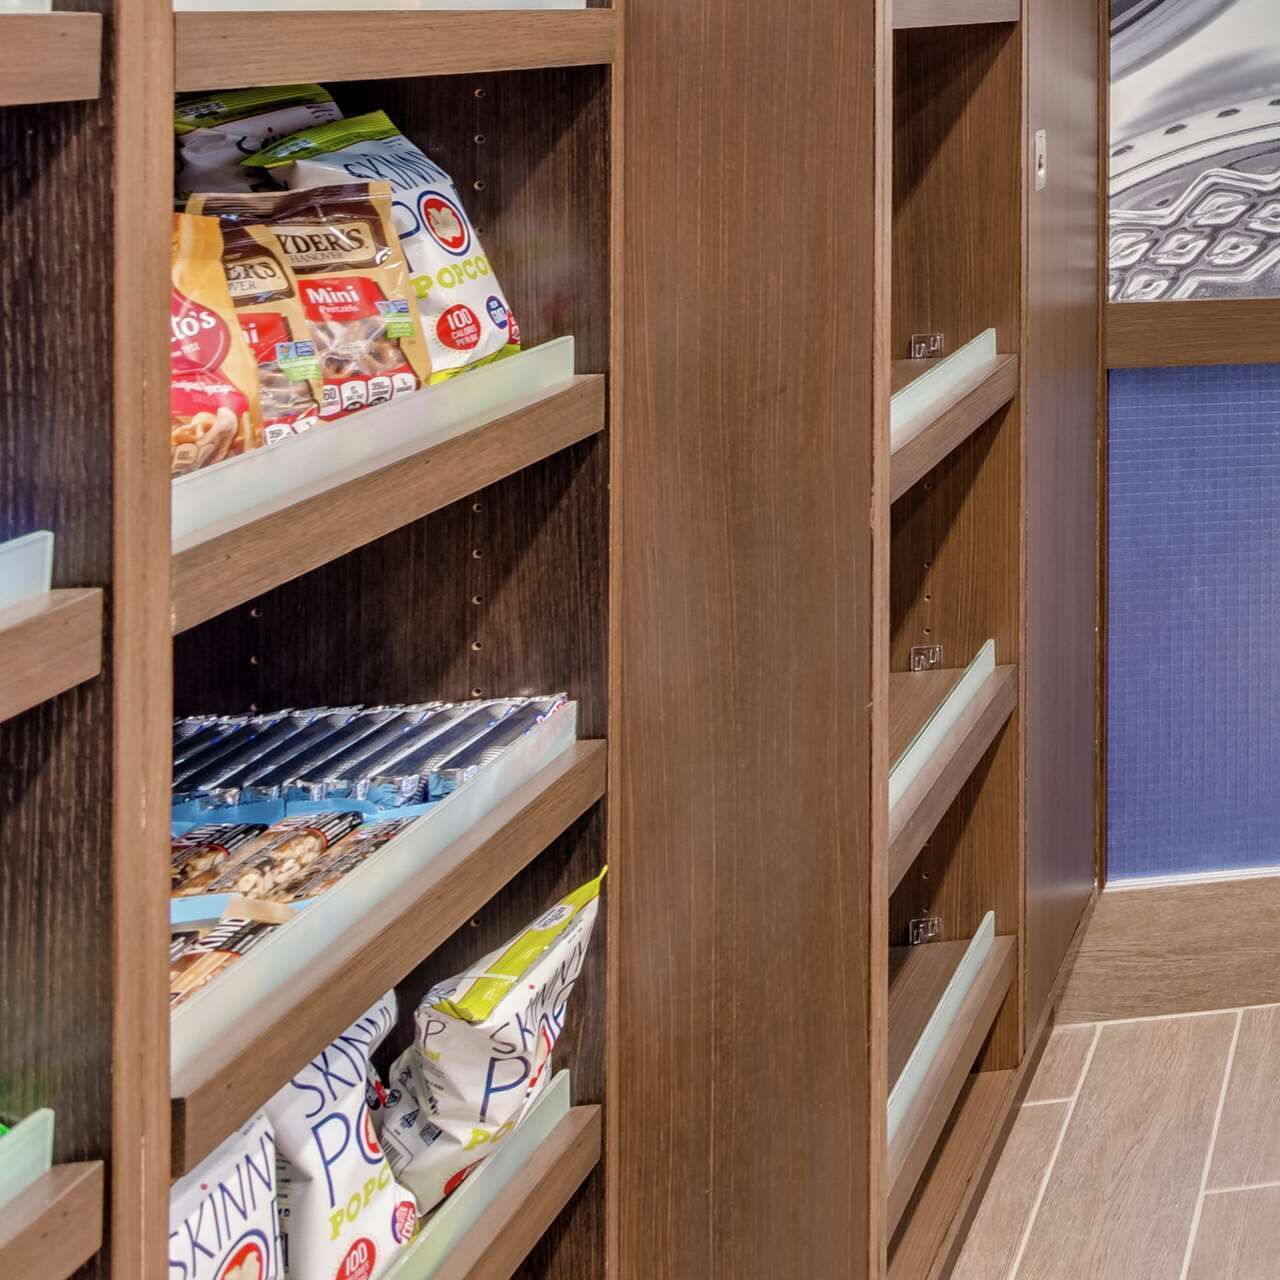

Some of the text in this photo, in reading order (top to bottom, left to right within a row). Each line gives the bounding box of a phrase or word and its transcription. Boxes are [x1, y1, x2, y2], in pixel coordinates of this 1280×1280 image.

[344, 150, 455, 194] SKINN
[277, 227, 365, 255] YDER'S
[307, 285, 360, 304] Mini
[411, 256, 491, 301] POPCO
[447, 308, 473, 331] 100
[329, 1164, 391, 1241] POPC
